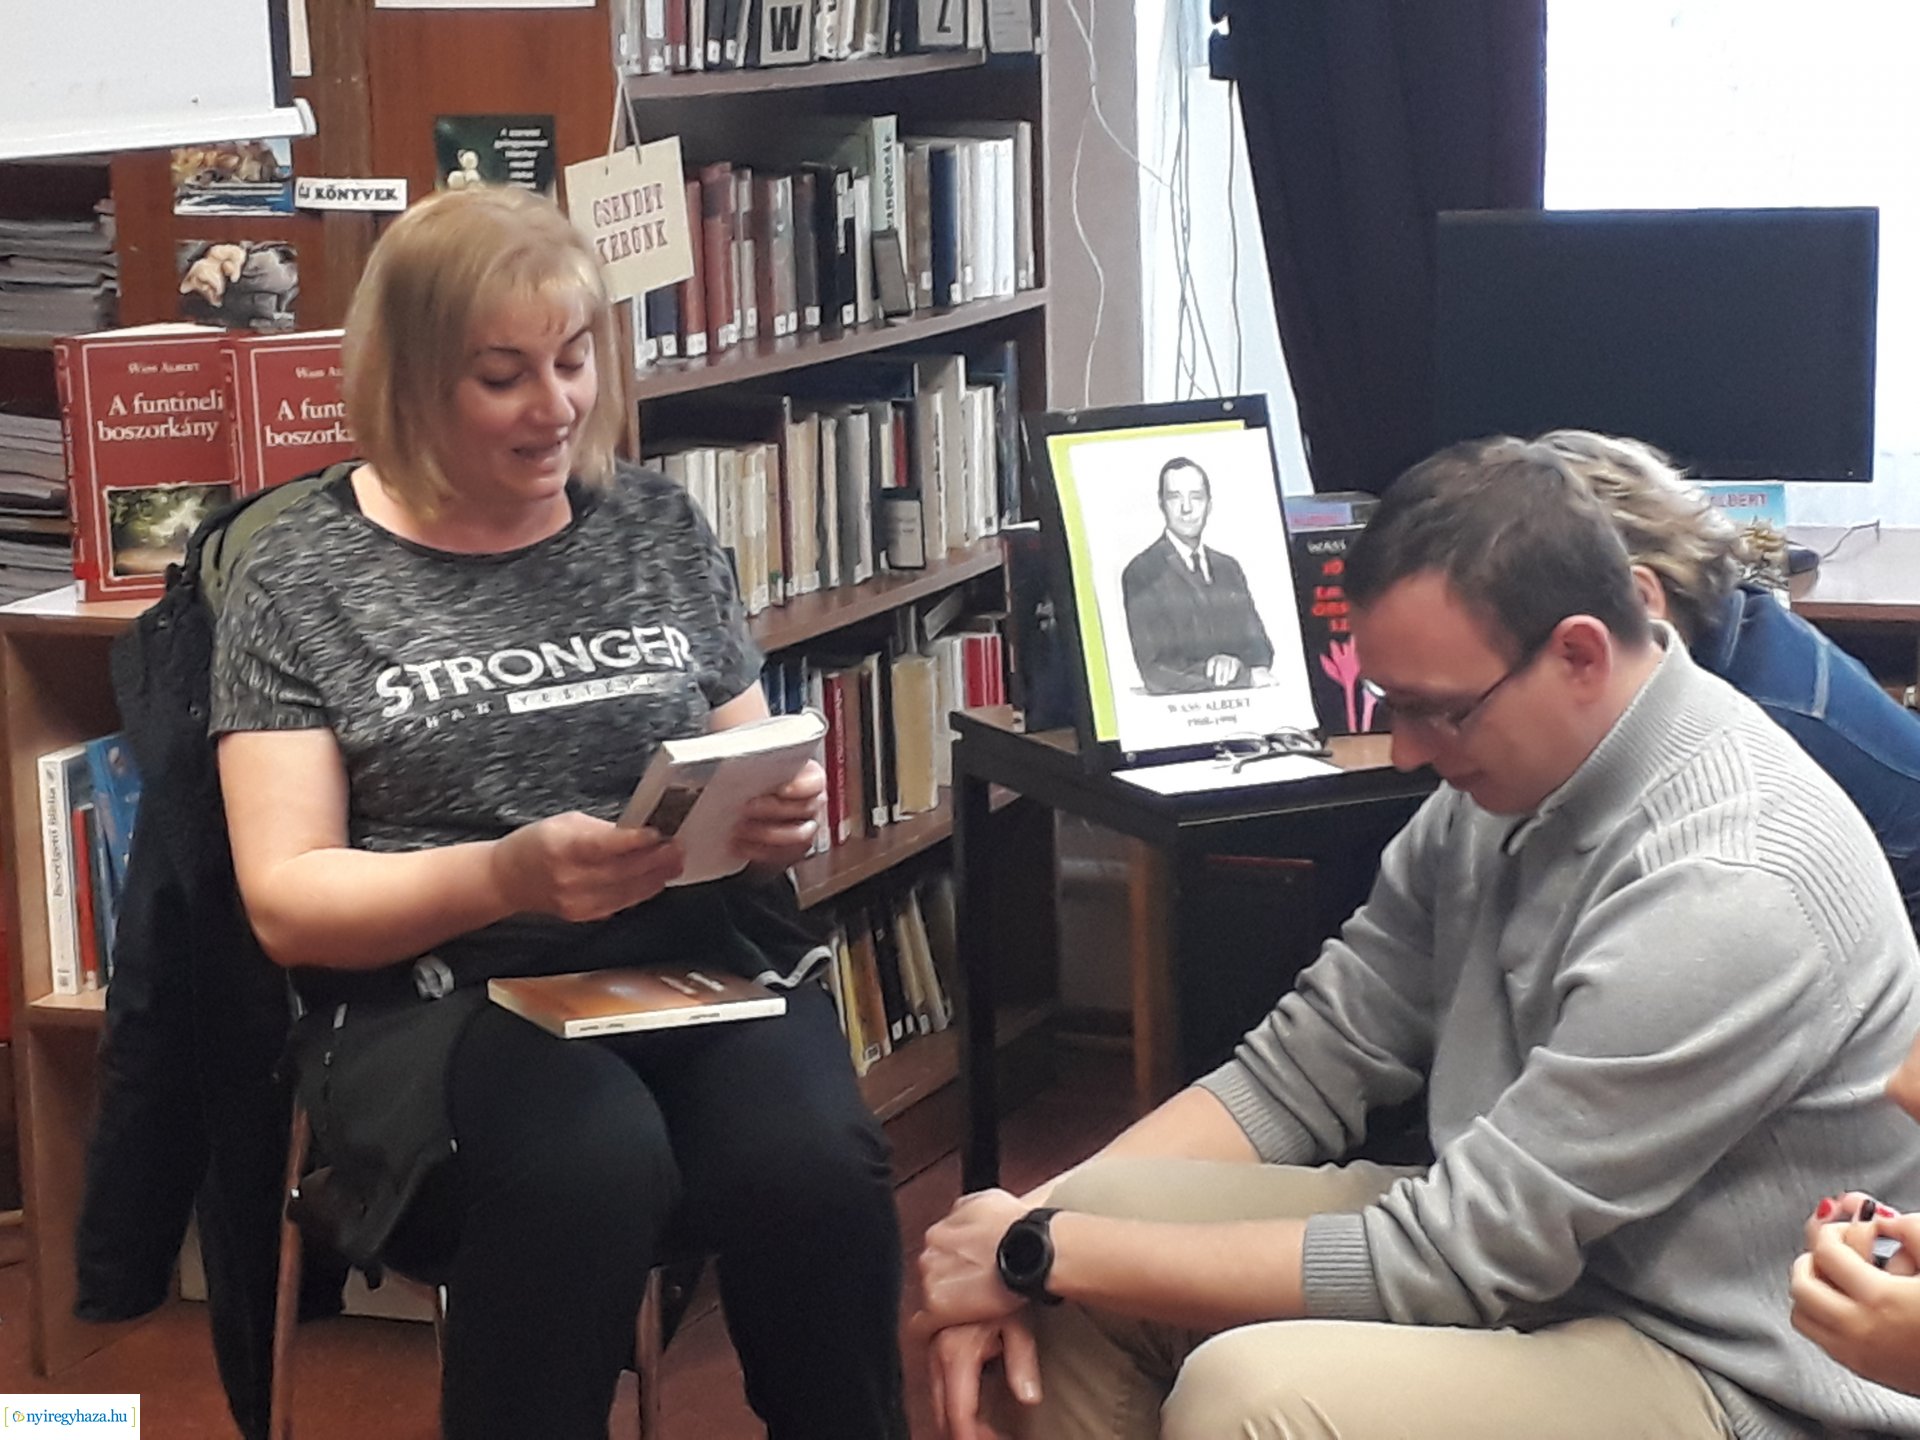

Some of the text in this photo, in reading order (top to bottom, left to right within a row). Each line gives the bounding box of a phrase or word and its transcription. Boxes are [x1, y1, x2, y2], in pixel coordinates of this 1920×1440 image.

[769, 6, 801, 52] W
[315, 184, 398, 201] KÖNYVEK
[593, 182, 664, 229] CSENDET
[108, 388, 224, 416] A funtineli
[278, 397, 347, 421] A funt
[97, 415, 219, 442] boszorkány
[264, 420, 355, 447] boszork
[376, 624, 694, 718] STRONGER
